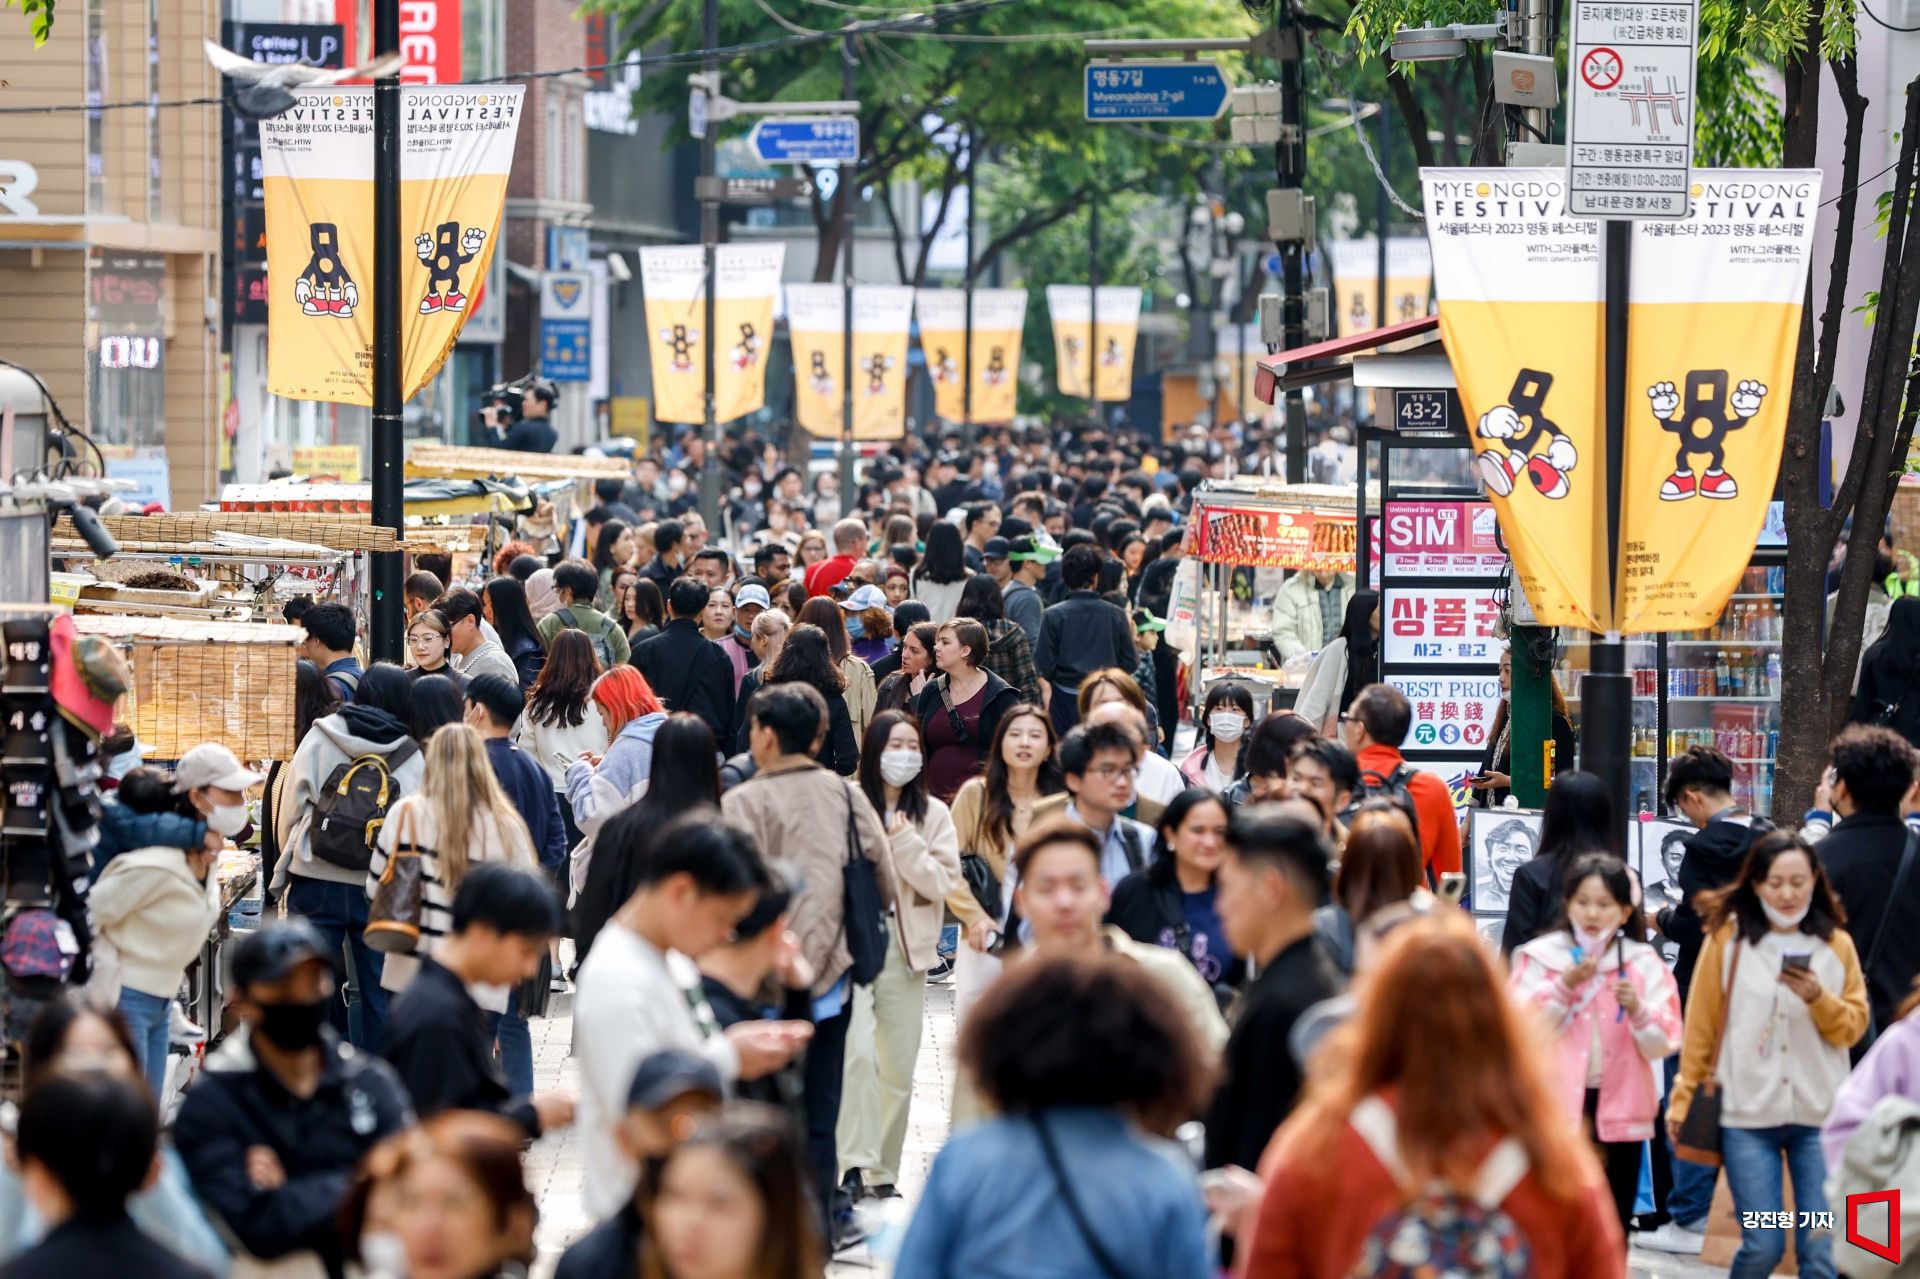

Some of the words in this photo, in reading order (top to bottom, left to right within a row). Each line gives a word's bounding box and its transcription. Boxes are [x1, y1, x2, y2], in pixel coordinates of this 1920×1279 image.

[1651, 7, 1687, 22] 모든차량
[1667, 26, 1687, 40] 제외)
[252, 35, 299, 51] Coffee
[1093, 70, 1143, 87] 명동7길
[1093, 92, 1158, 103] Myeongdong
[1577, 148, 1597, 162] 구간
[1604, 148, 1662, 163] 명동관광특구
[1665, 150, 1683, 163] 일대
[1434, 182, 1566, 198] MYEONGDO
[1436, 201, 1565, 217] FESTIV
[1585, 196, 1672, 210] 남대문경찰서장
[1688, 202, 1805, 218] STIVAL
[1438, 222, 1492, 236] 서울페스타
[1495, 223, 1524, 235] 2023
[1527, 222, 1549, 235] 명동
[1552, 222, 1597, 235] 페스티벌
[1642, 223, 1698, 236] 서울페스타
[1701, 224, 1730, 236] 2023
[1733, 223, 1756, 236] 명동
[1758, 223, 1804, 236] 페스티벌
[1401, 402, 1442, 419] 43-2
[1440, 511, 1455, 519] LTE
[1389, 515, 1454, 546] SIM
[10, 641, 41, 661] 대장
[1414, 643, 1442, 656] 사고
[1458, 643, 1486, 656] 팔고
[1392, 682, 1442, 698] BEST
[1448, 682, 1501, 698] PRIC
[1417, 701, 1484, 721] 替換錢
